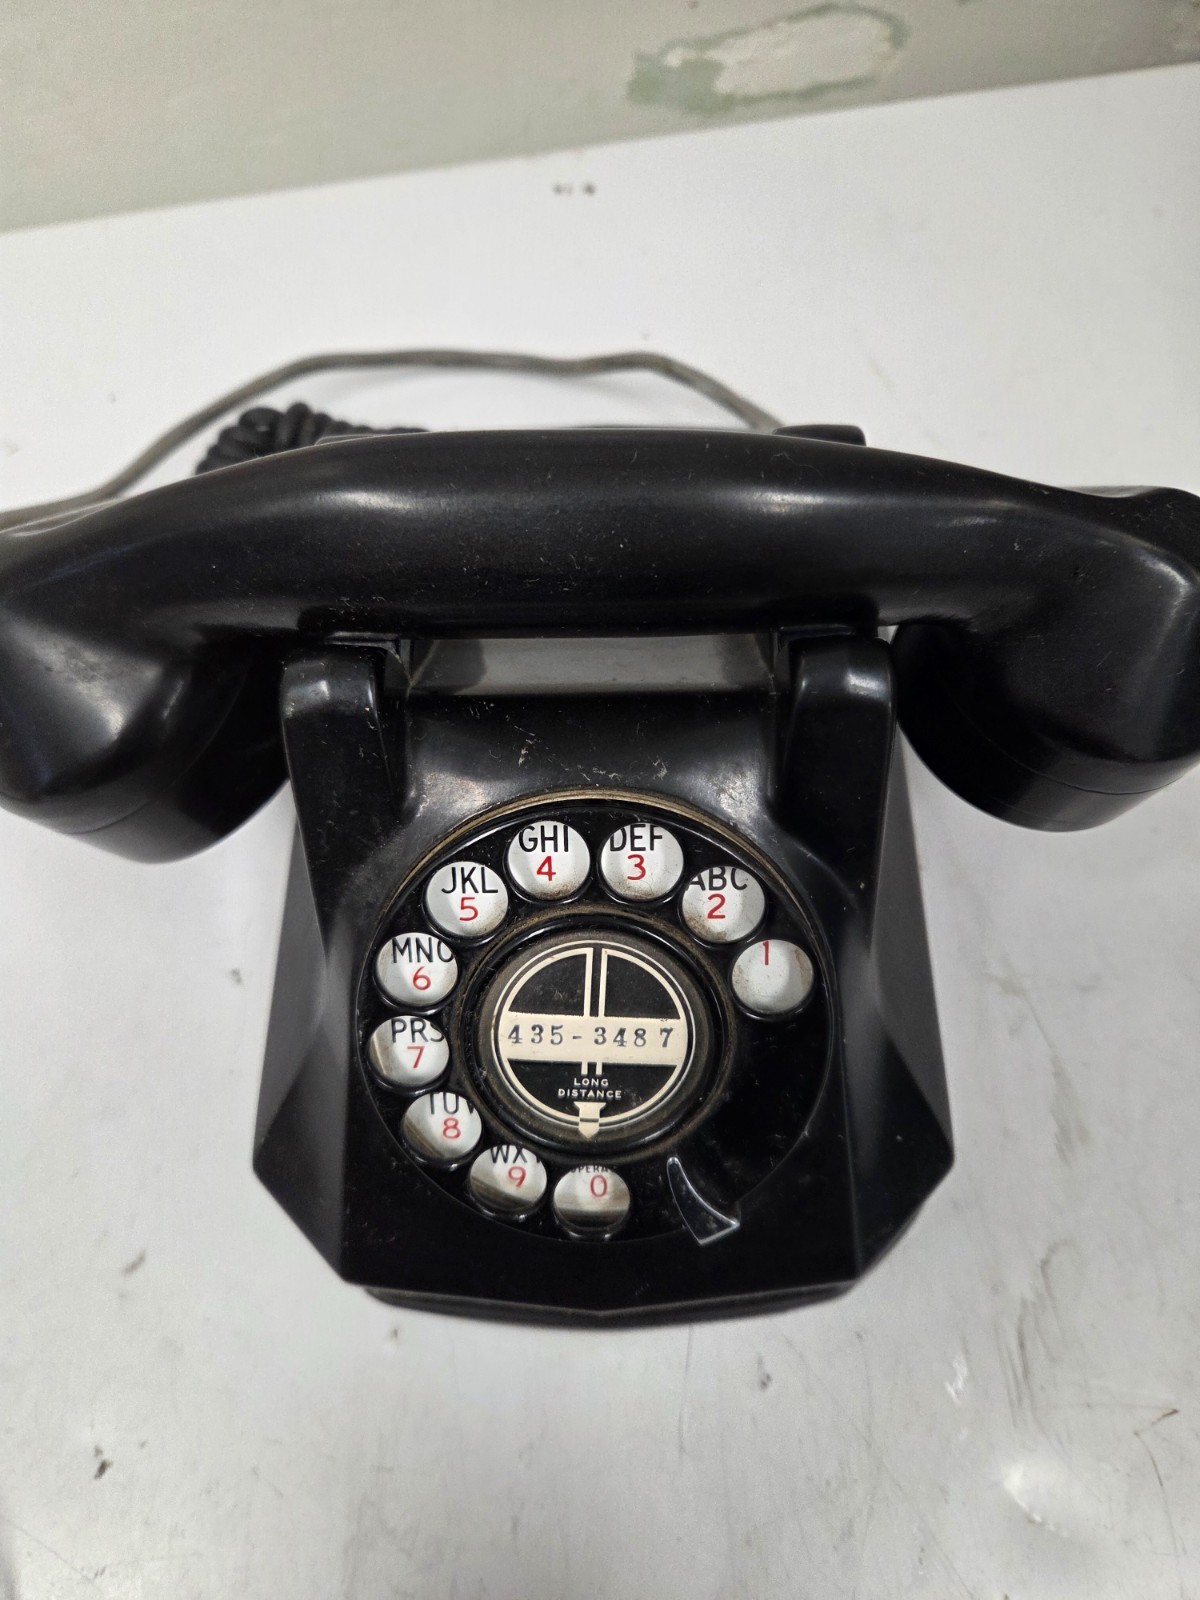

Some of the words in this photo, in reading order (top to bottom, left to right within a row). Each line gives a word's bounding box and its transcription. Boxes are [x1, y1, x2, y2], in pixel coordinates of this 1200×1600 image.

[518, 825, 569, 852] GHI
[609, 824, 663, 851] DEF
[536, 855, 556, 881] 4
[627, 854, 646, 880] 3
[686, 867, 748, 891] ABC
[441, 866, 498, 894] JKL
[459, 897, 478, 921] 5
[707, 893, 726, 919] 2
[762, 940, 769, 966] 1
[412, 966, 431, 990] 6
[407, 1045, 425, 1069] 7
[558, 1089, 622, 1099] DISTANCE
[574, 1078, 609, 1086] LONG
[443, 1117, 461, 1139] 8
[490, 1144, 541, 1163] WX
[508, 1166, 526, 1188] 9
[590, 1174, 607, 1197] 0
